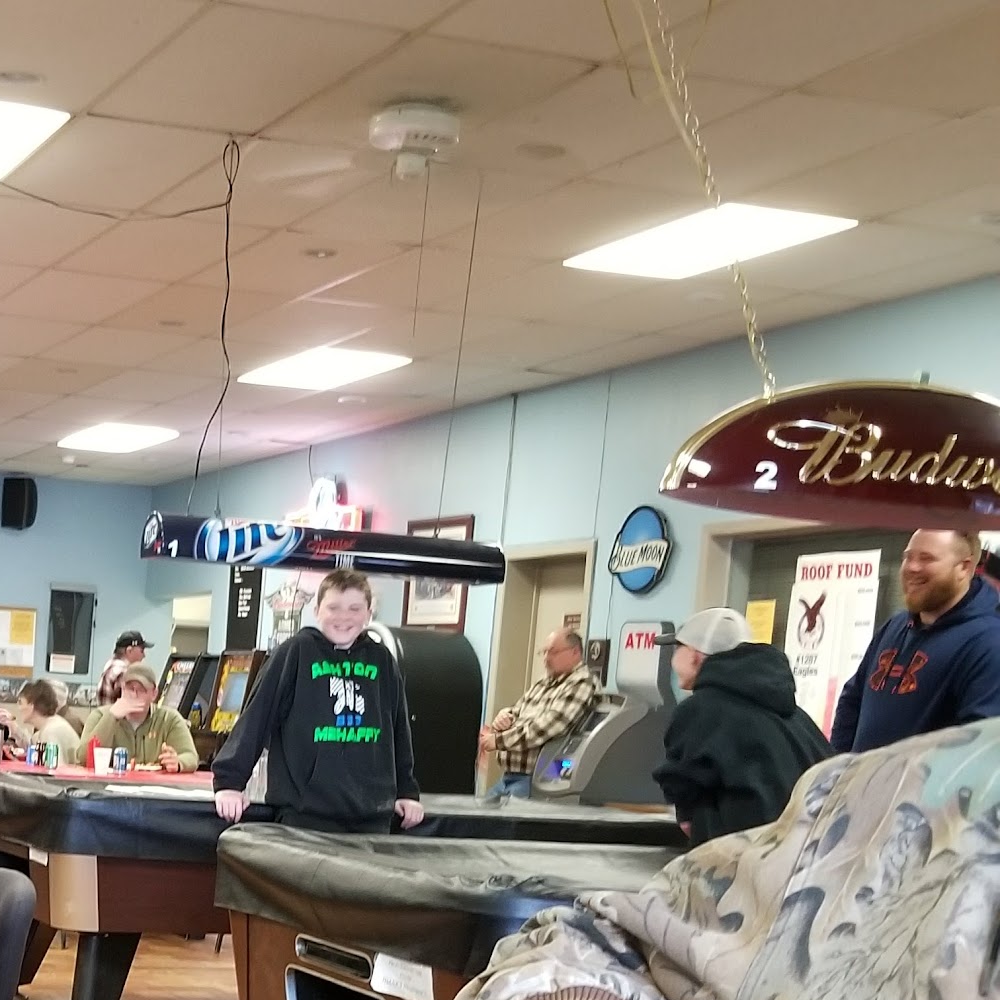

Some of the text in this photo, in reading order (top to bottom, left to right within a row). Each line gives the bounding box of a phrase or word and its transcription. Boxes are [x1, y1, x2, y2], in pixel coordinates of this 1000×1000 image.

[753, 460, 778, 490] 2
[167, 539, 179, 558] 1
[611, 543, 665, 571] BLUE MOON
[801, 563, 873, 581] ROOF FUND
[625, 632, 657, 651] ATM
